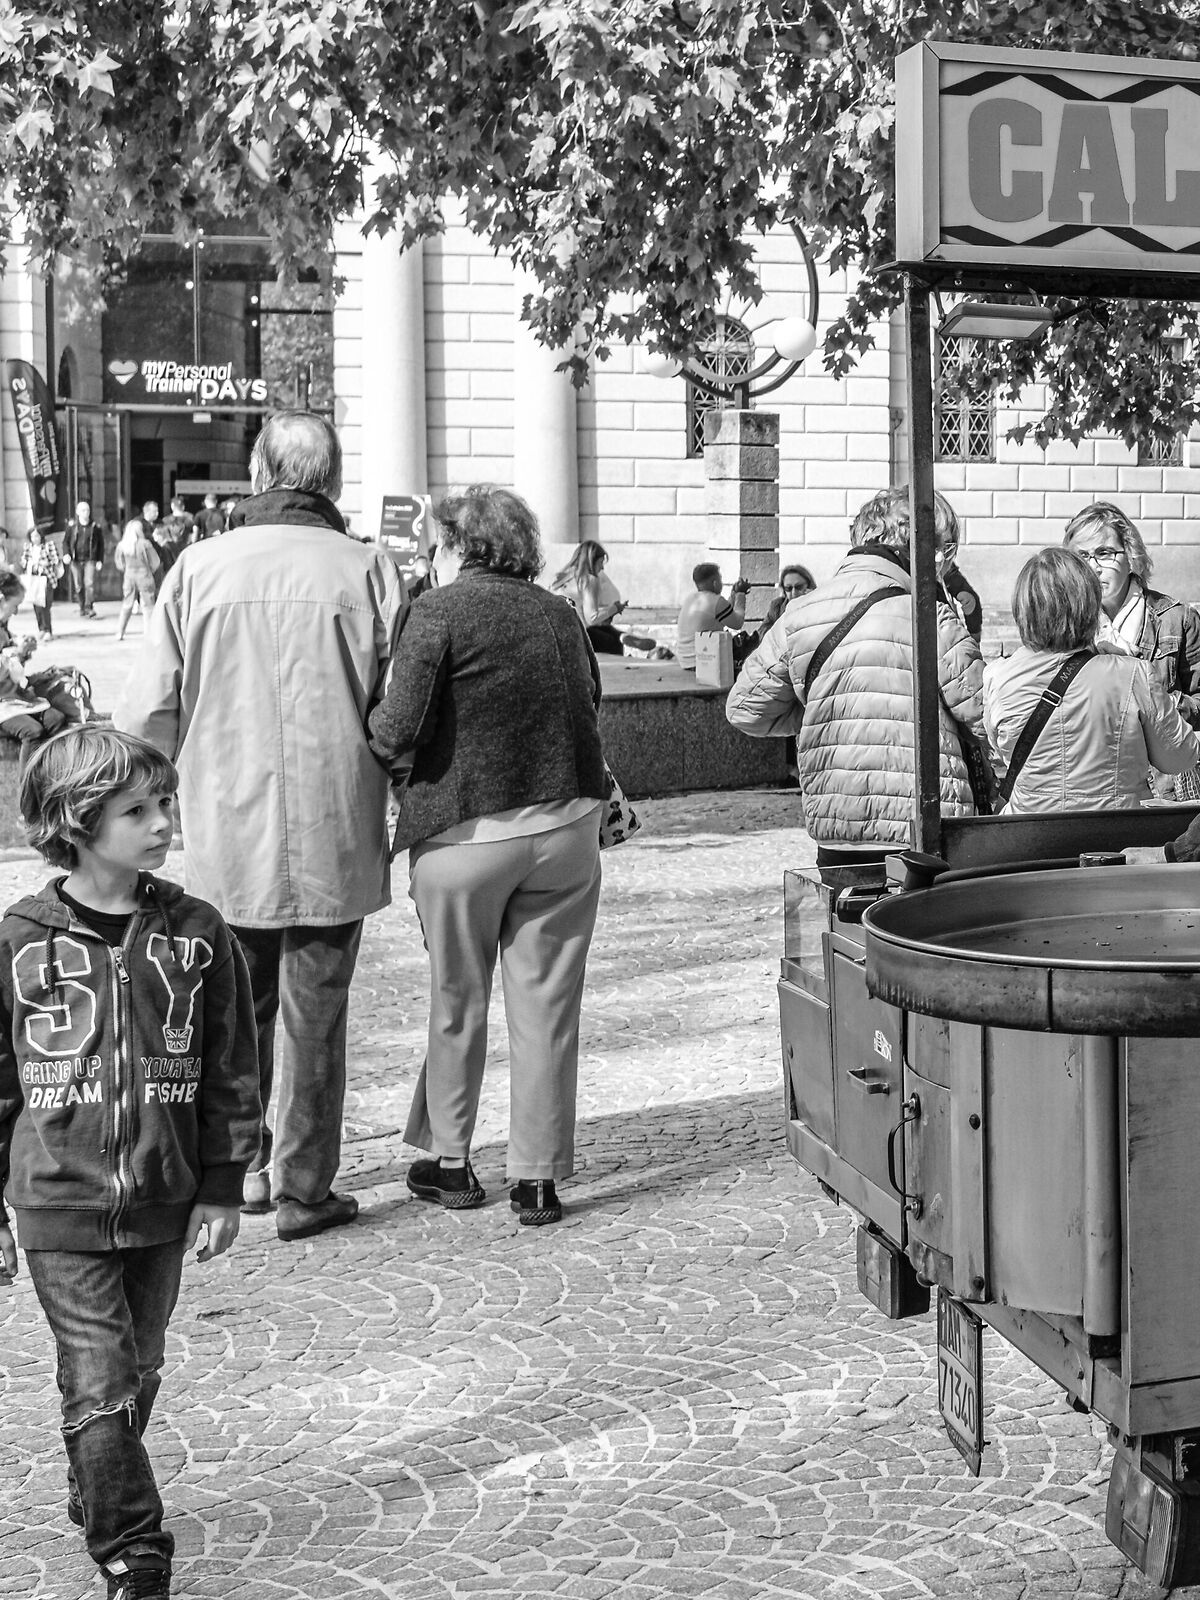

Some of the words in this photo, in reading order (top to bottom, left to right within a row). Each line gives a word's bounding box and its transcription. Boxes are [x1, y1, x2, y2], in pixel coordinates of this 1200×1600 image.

[145, 374, 200, 392] Trainer
[201, 378, 267, 400] DAYS
[75, 1055, 101, 1079] UP
[29, 1080, 103, 1109] DREAM
[939, 1356, 976, 1434] 71340
